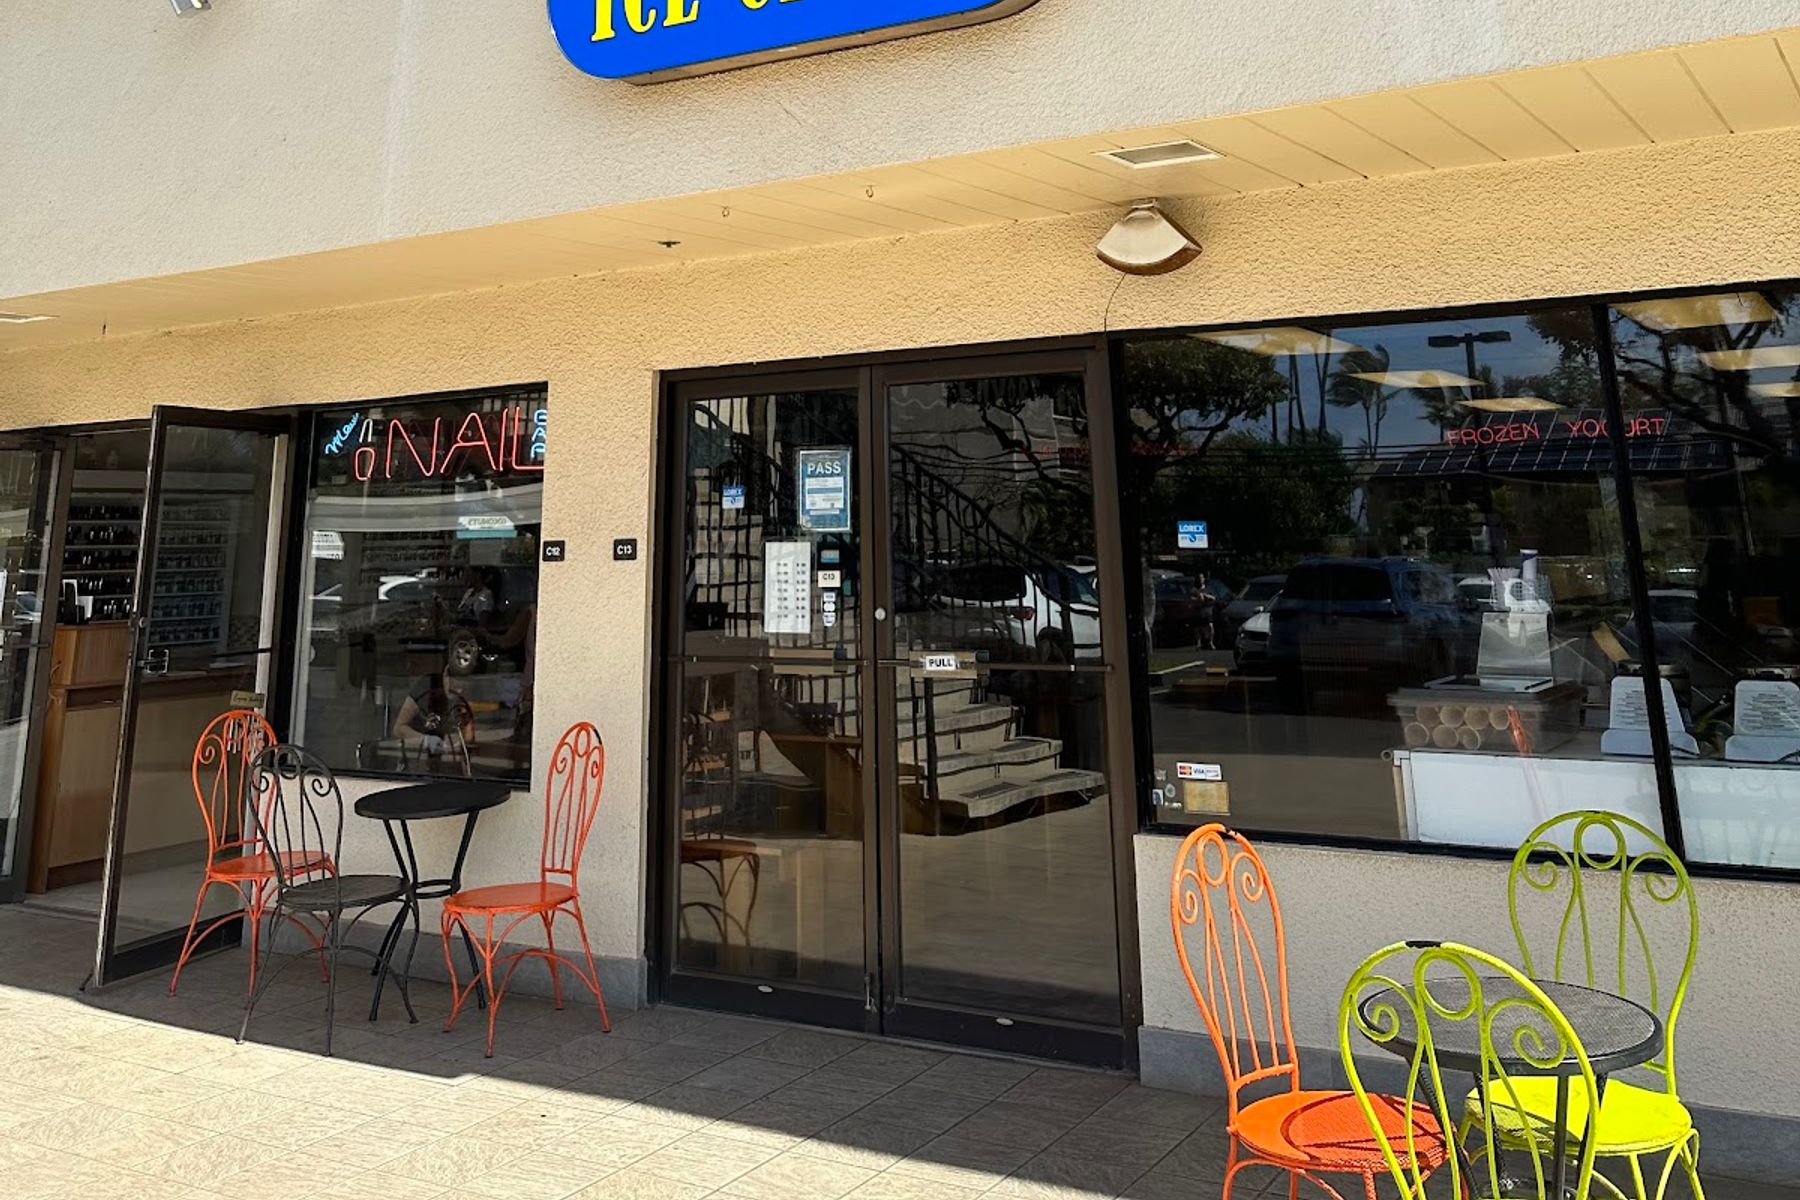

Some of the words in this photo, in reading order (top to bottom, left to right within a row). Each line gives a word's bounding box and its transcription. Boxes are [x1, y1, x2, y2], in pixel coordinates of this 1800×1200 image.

[1447, 422, 1540, 447] FROZEN
[385, 406, 545, 479] NAIL
[807, 460, 842, 475] PASS
[616, 544, 633, 555] C13
[928, 658, 953, 667] PULL
